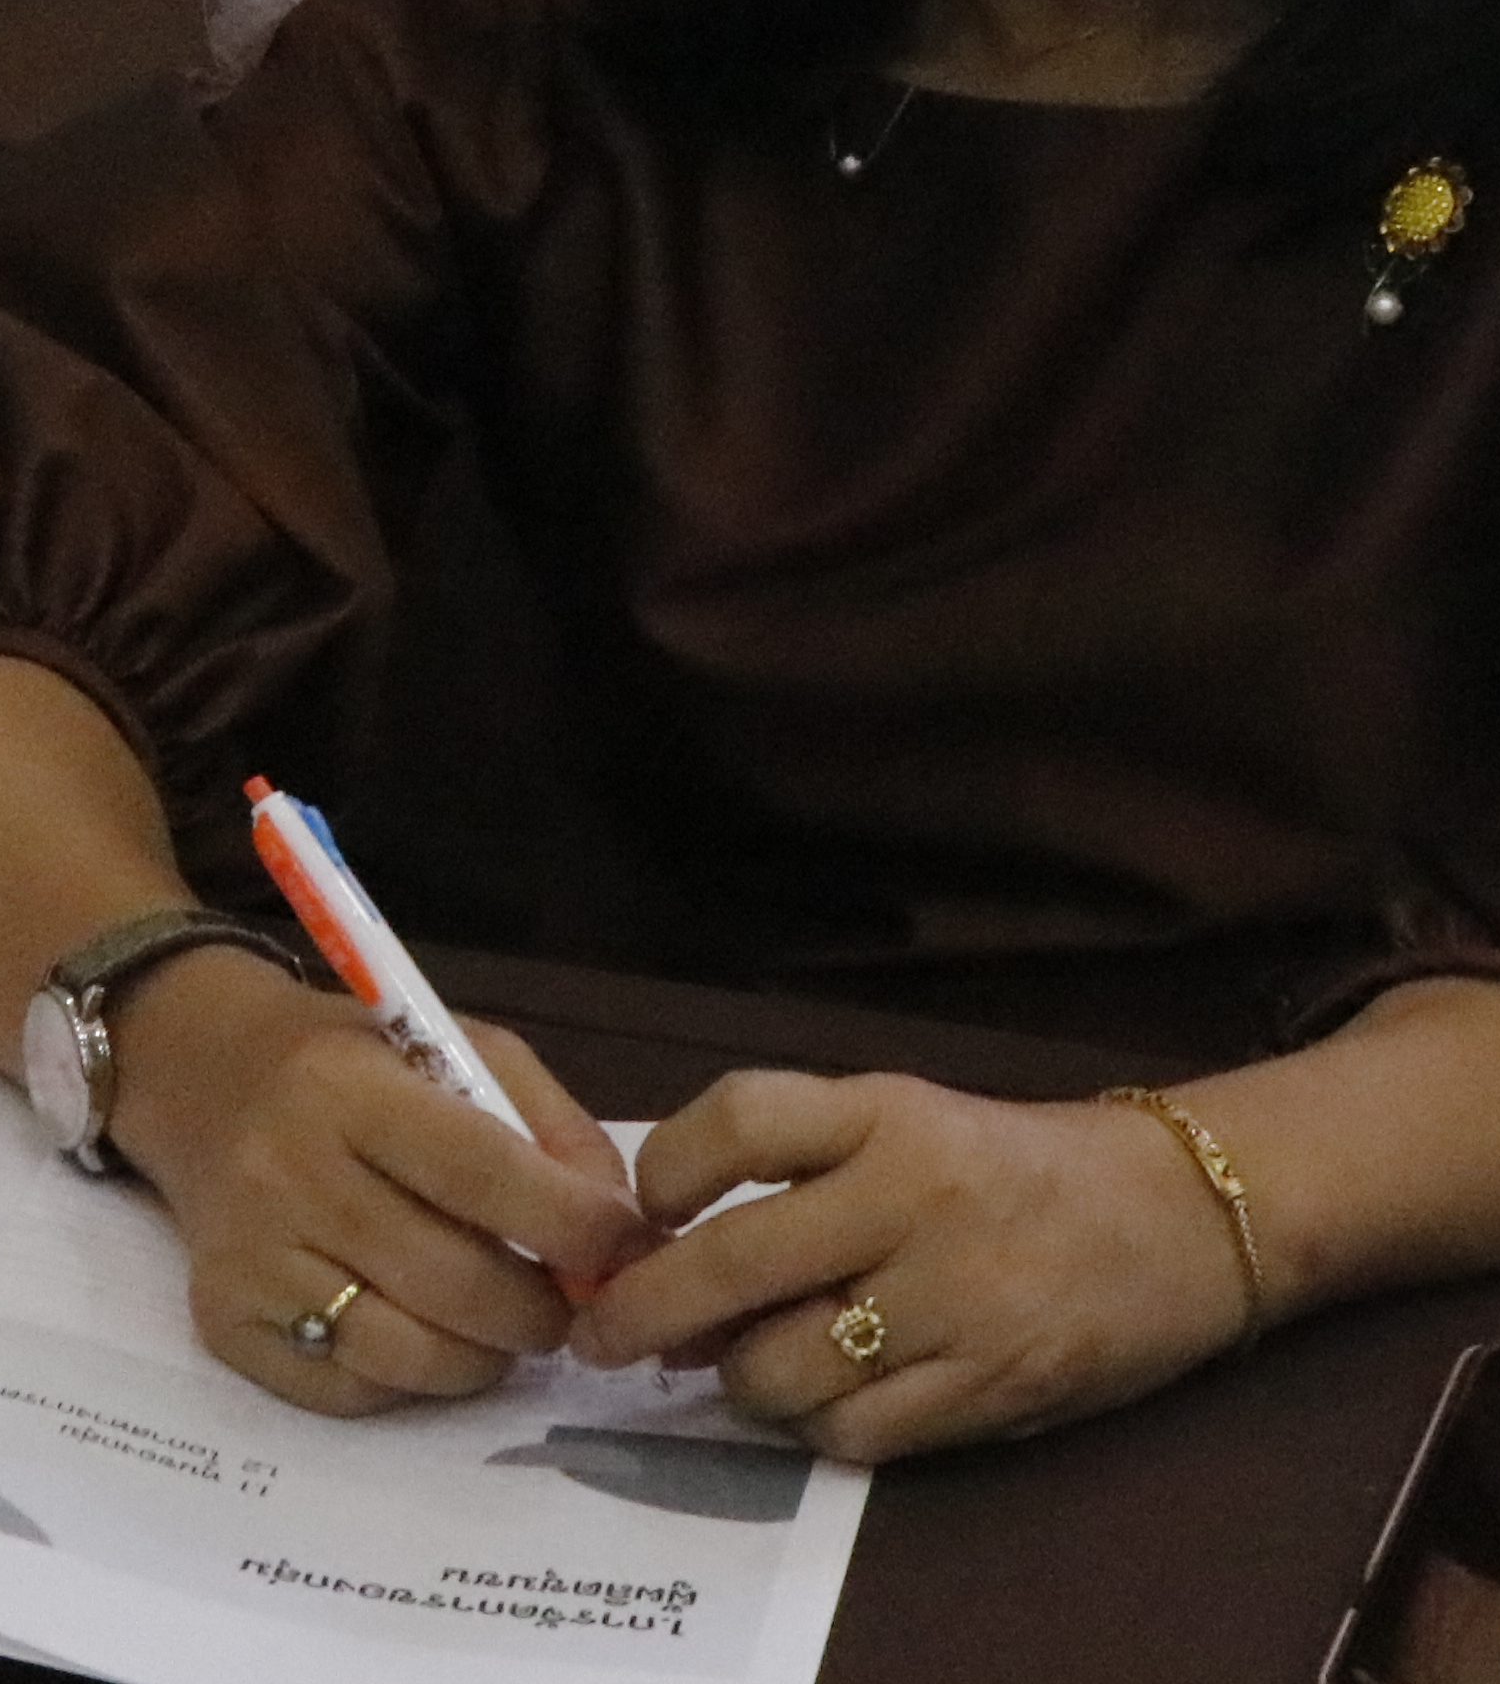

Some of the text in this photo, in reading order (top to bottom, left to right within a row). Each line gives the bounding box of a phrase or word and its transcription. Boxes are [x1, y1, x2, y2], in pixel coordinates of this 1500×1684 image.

[441, 1568, 697, 1613] ผู้ผลิตชุมชน
